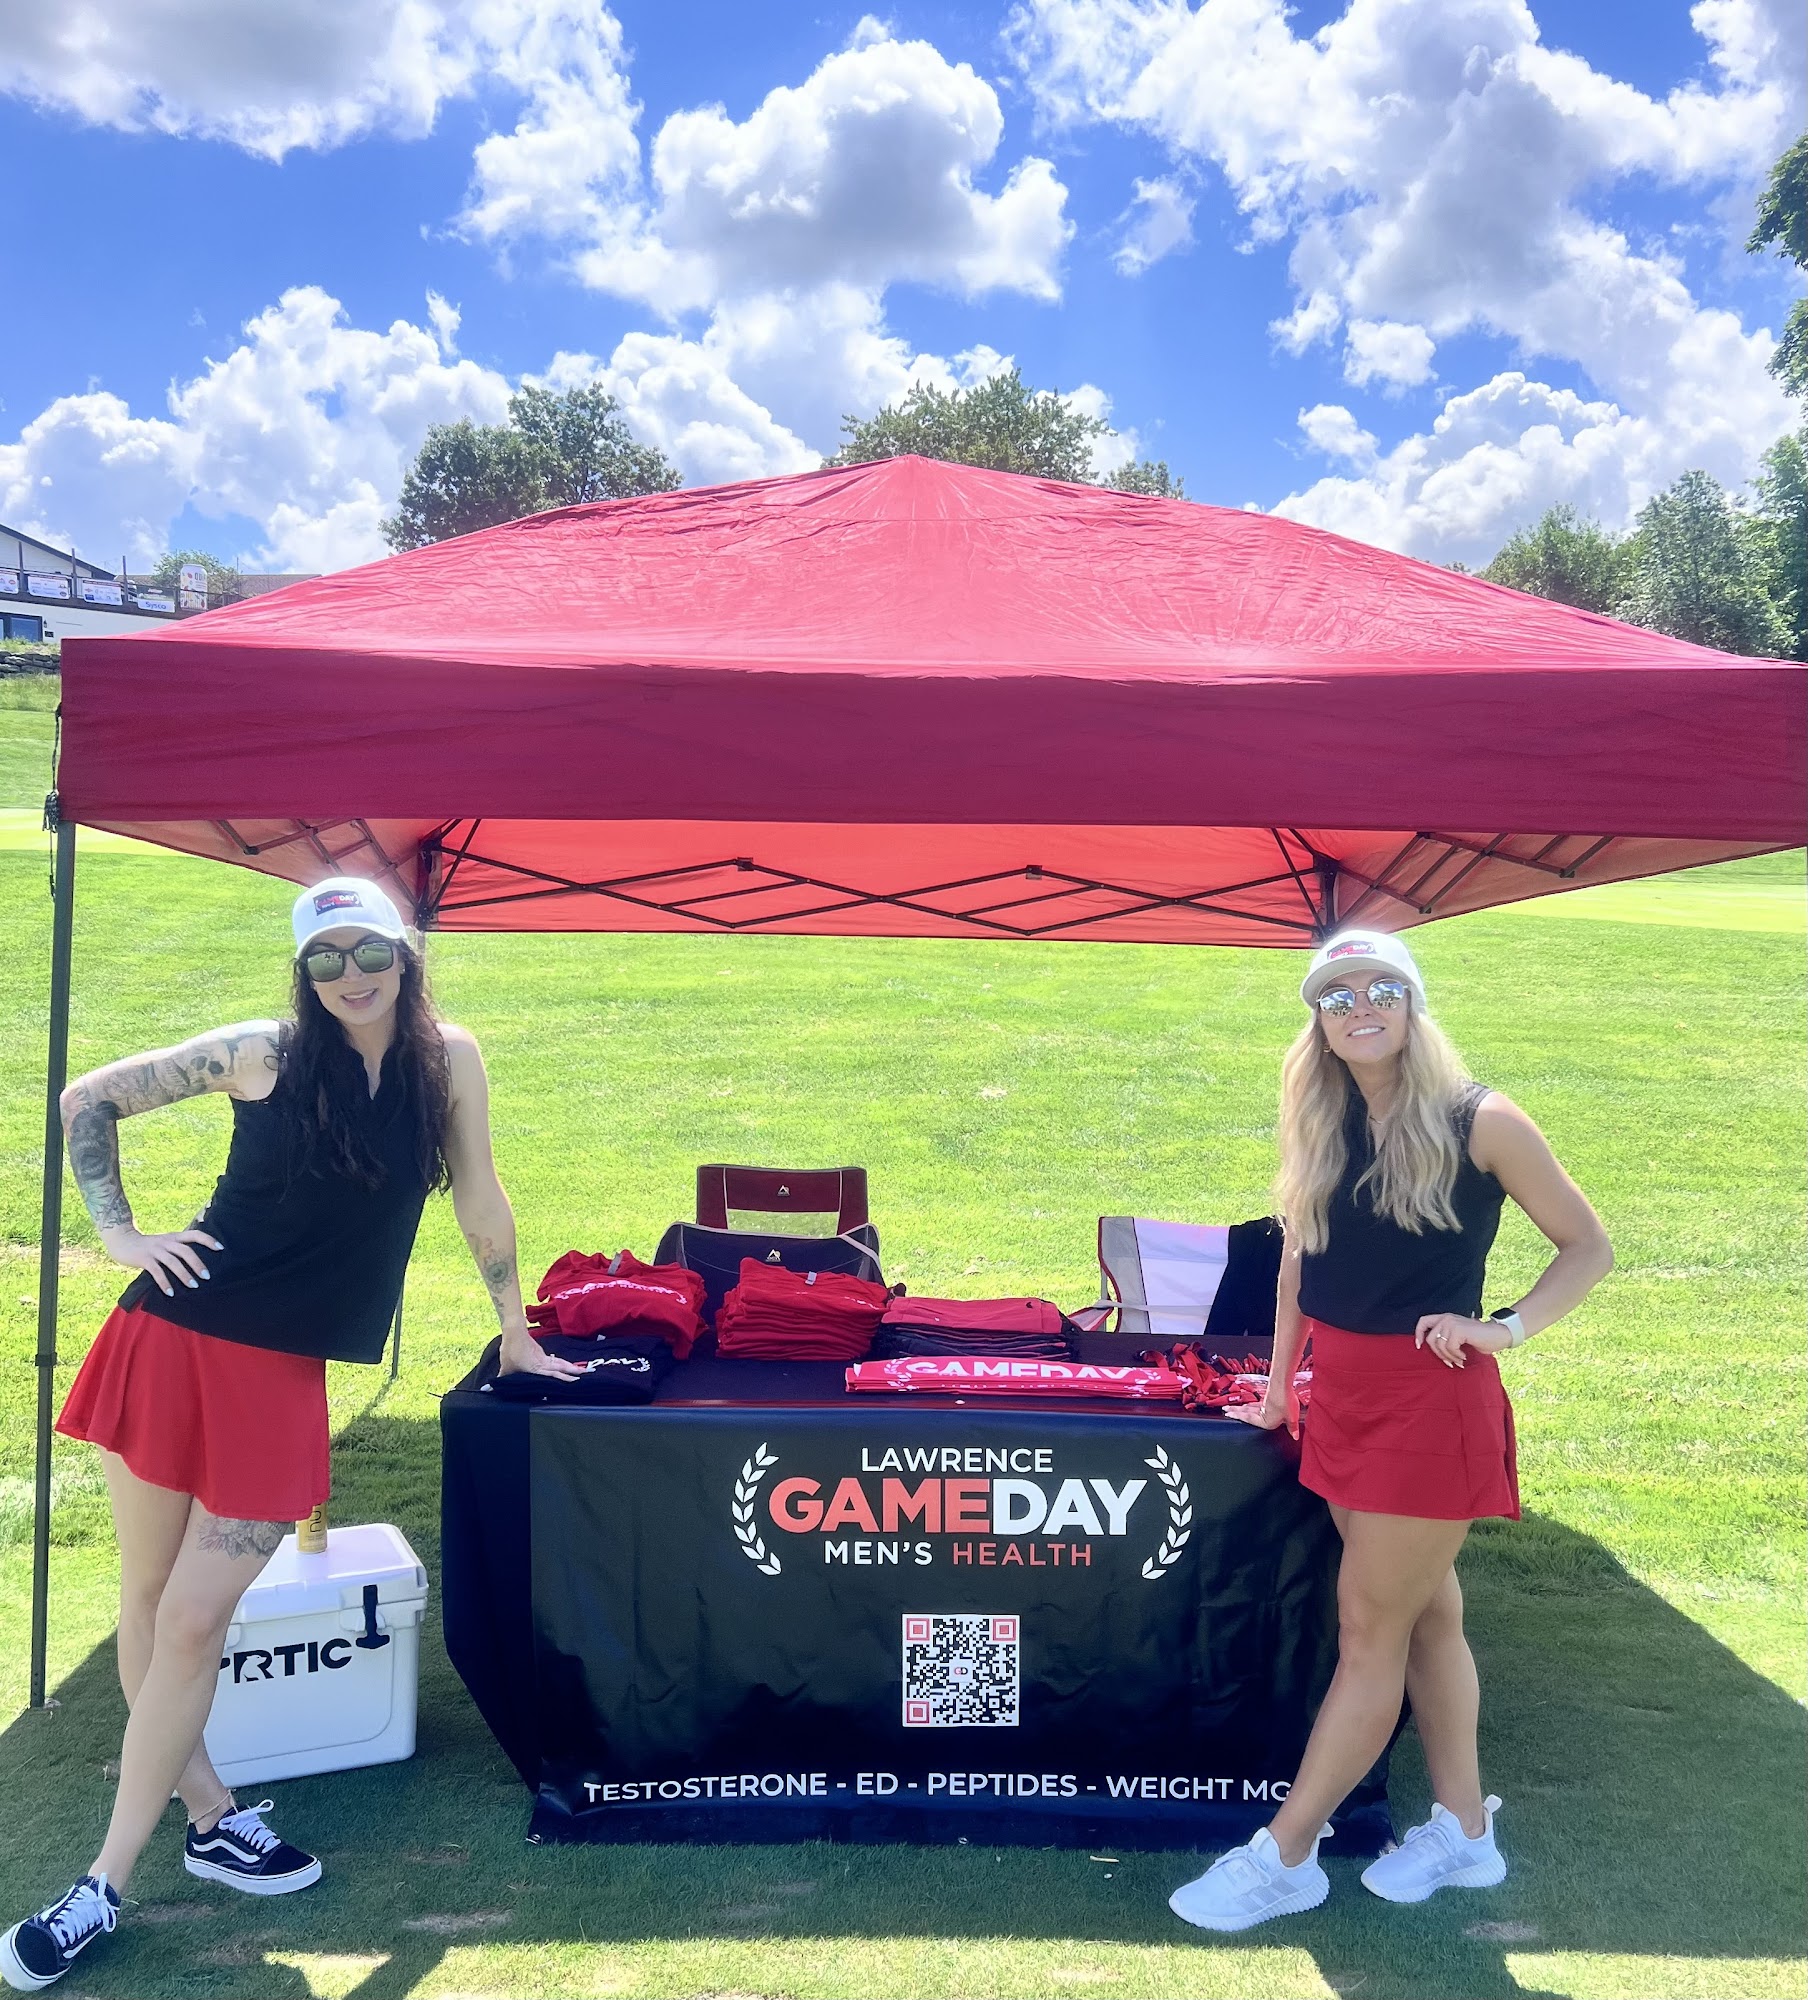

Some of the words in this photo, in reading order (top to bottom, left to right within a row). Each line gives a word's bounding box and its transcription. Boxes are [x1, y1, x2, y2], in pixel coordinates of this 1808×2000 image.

[145, 601, 167, 610] Sysco
[862, 1448, 1053, 1472] LAWRENCE
[769, 1477, 1147, 1535] GAMEDAY
[953, 1543, 1091, 1566] HEALTH
[233, 1638, 353, 1684] RTIC
[584, 1773, 828, 1802] TESTOSTERONE
[857, 1773, 899, 1795] ED
[928, 1773, 1077, 1797] PEPTIDES
[1106, 1776, 1233, 1800] WEIGHT
